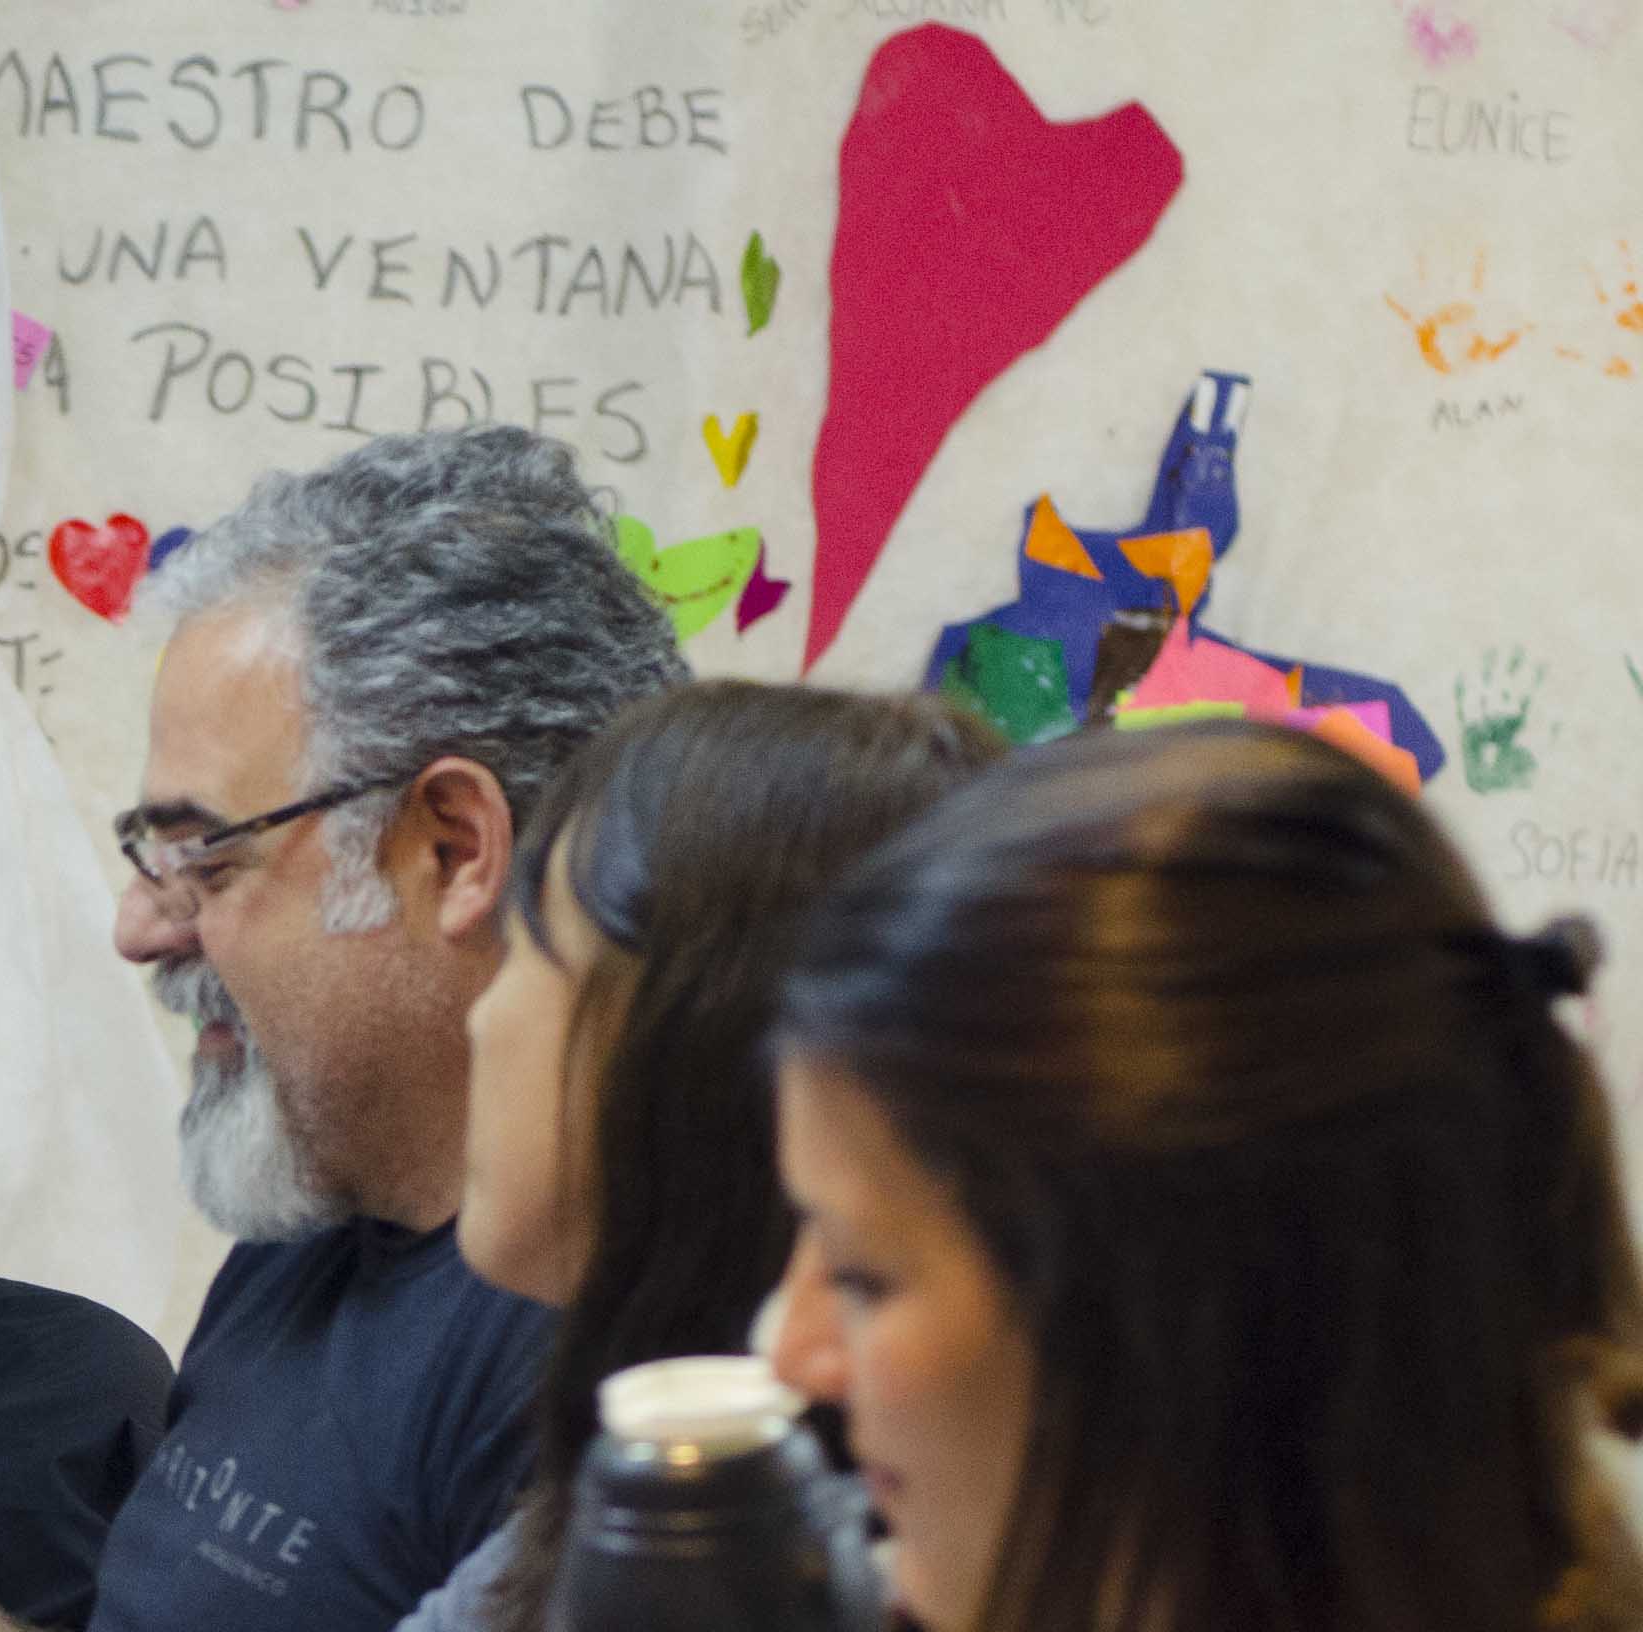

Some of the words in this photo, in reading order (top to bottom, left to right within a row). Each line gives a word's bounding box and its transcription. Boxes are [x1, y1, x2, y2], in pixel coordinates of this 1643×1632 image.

[521, 83, 732, 158] DEBE
[58, 214, 229, 287] UNA
[297, 222, 723, 316] VENTANA
